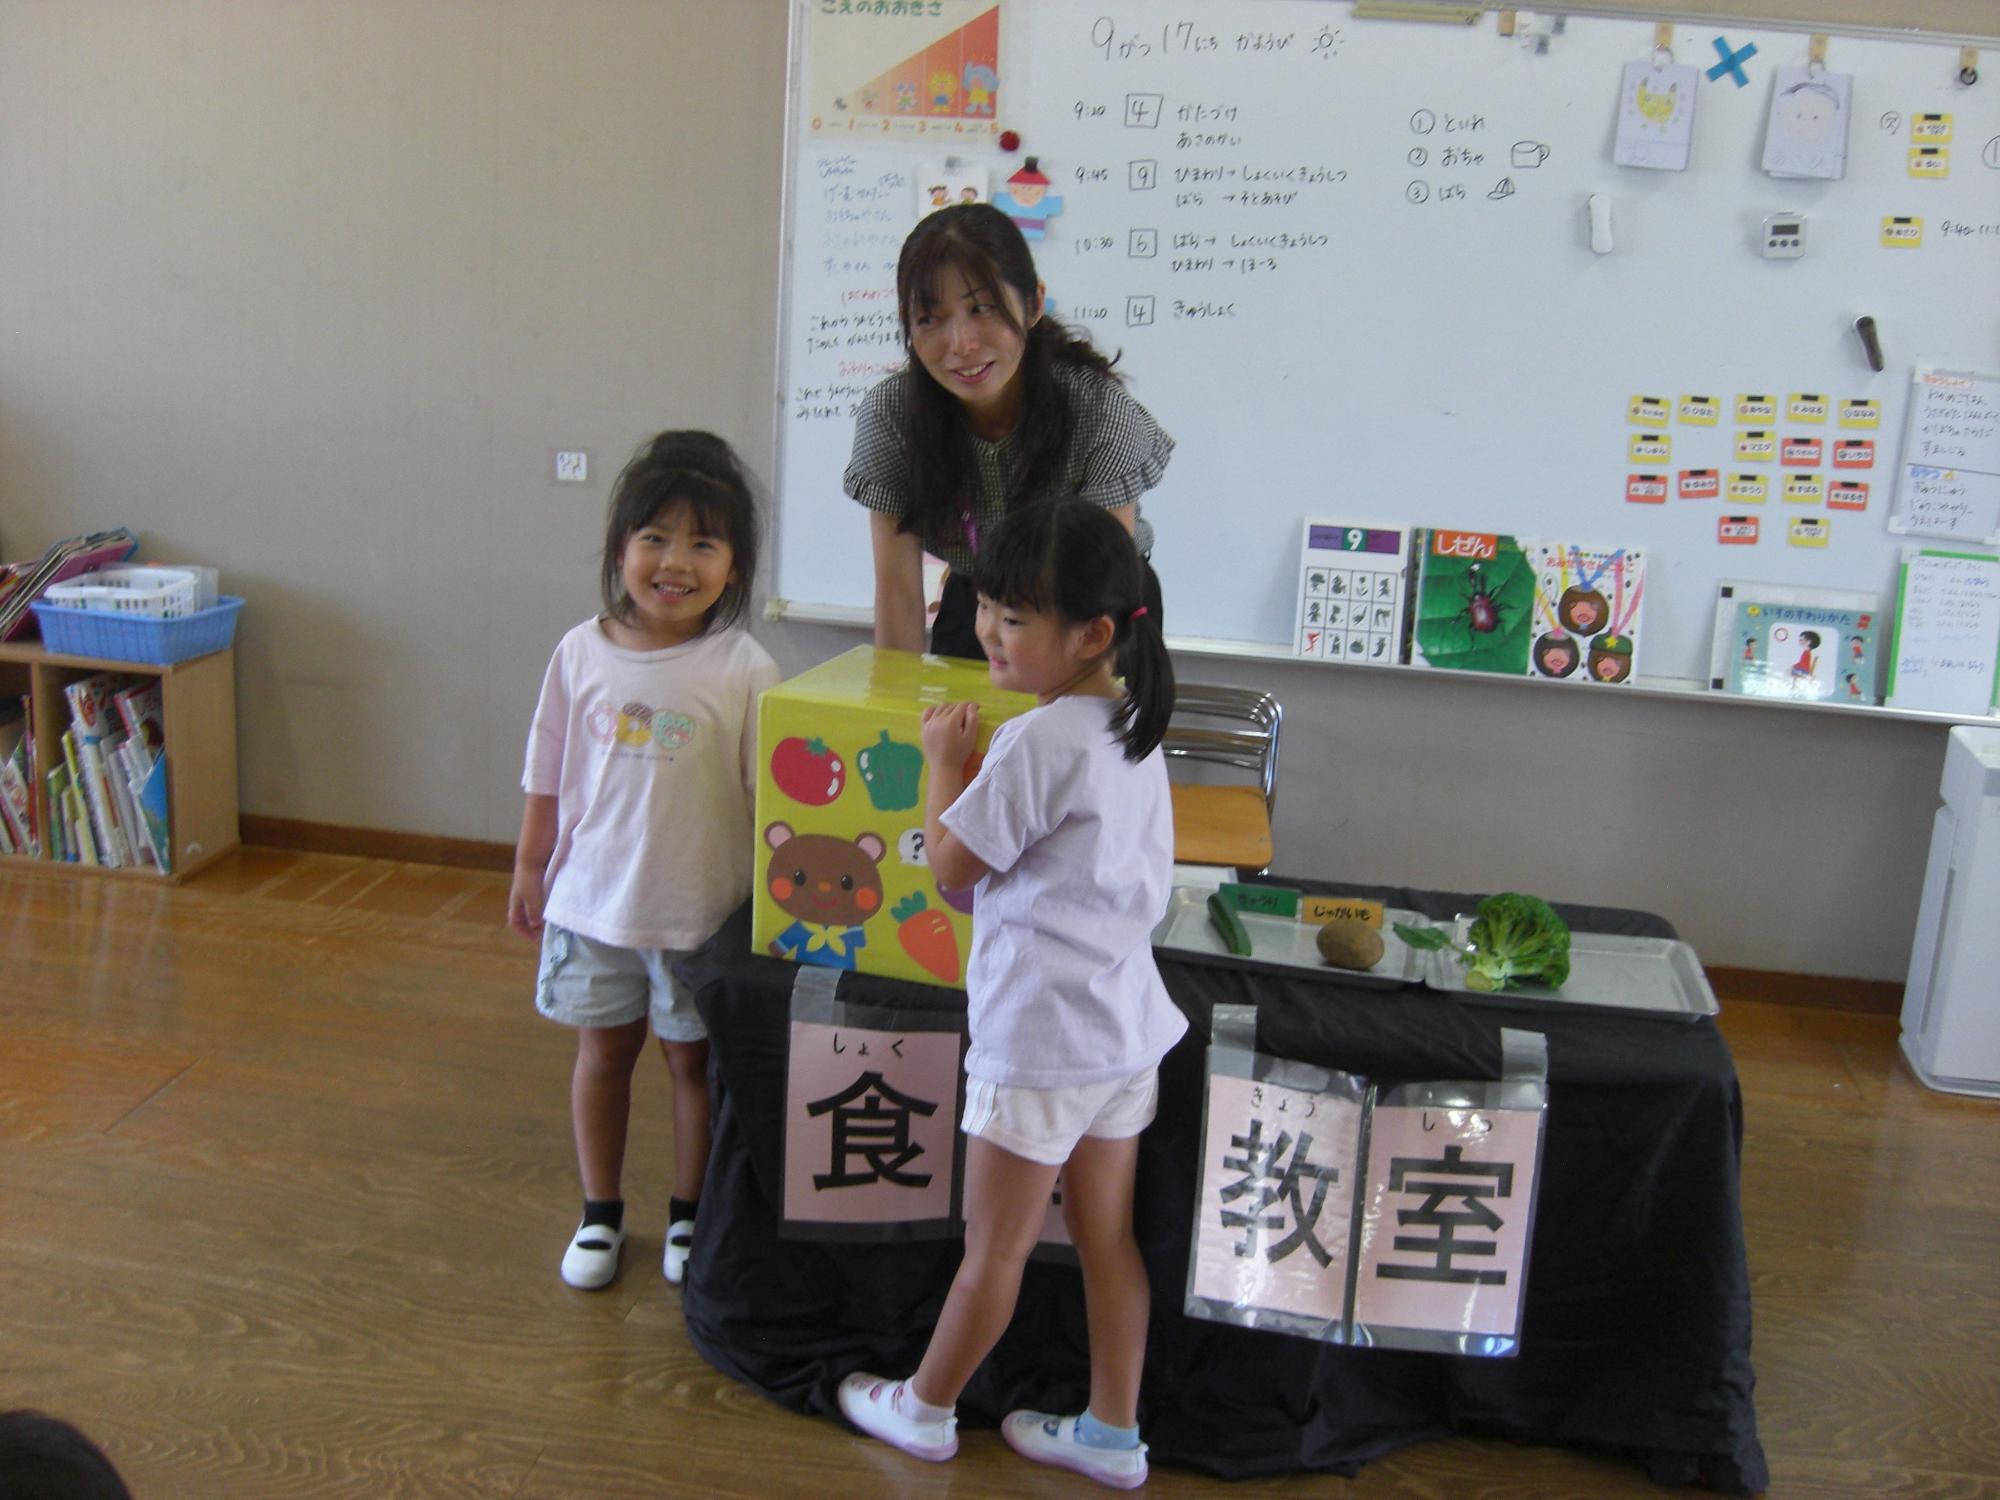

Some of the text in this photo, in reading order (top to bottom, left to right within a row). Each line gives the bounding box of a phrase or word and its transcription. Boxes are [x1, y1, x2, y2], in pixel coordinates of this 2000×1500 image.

[821, 0, 944, 17] こえのおおきさ
[812, 116, 823, 130] 0
[881, 119, 891, 133] 2
[918, 119, 928, 133] 3
[954, 121, 964, 133] 4
[989, 122, 999, 134] 5
[1443, 112, 1486, 133] といれ
[1176, 132, 1243, 150] あさのかい
[1441, 146, 1485, 167] おちゃ
[1175, 164, 1225, 183] ひまわり
[1243, 163, 1348, 183] しょくいくきょうしつ
[1231, 232, 1329, 248] しょくいくきょうしつ
[1171, 259, 1214, 273] ひまわり
[1346, 528, 1364, 552] 9
[1437, 533, 1495, 559] しぜん
[911, 831, 925, 860] ?
[833, 1033, 904, 1058] しょく
[1250, 1086, 1316, 1118] きょう
[806, 1071, 939, 1192] 食
